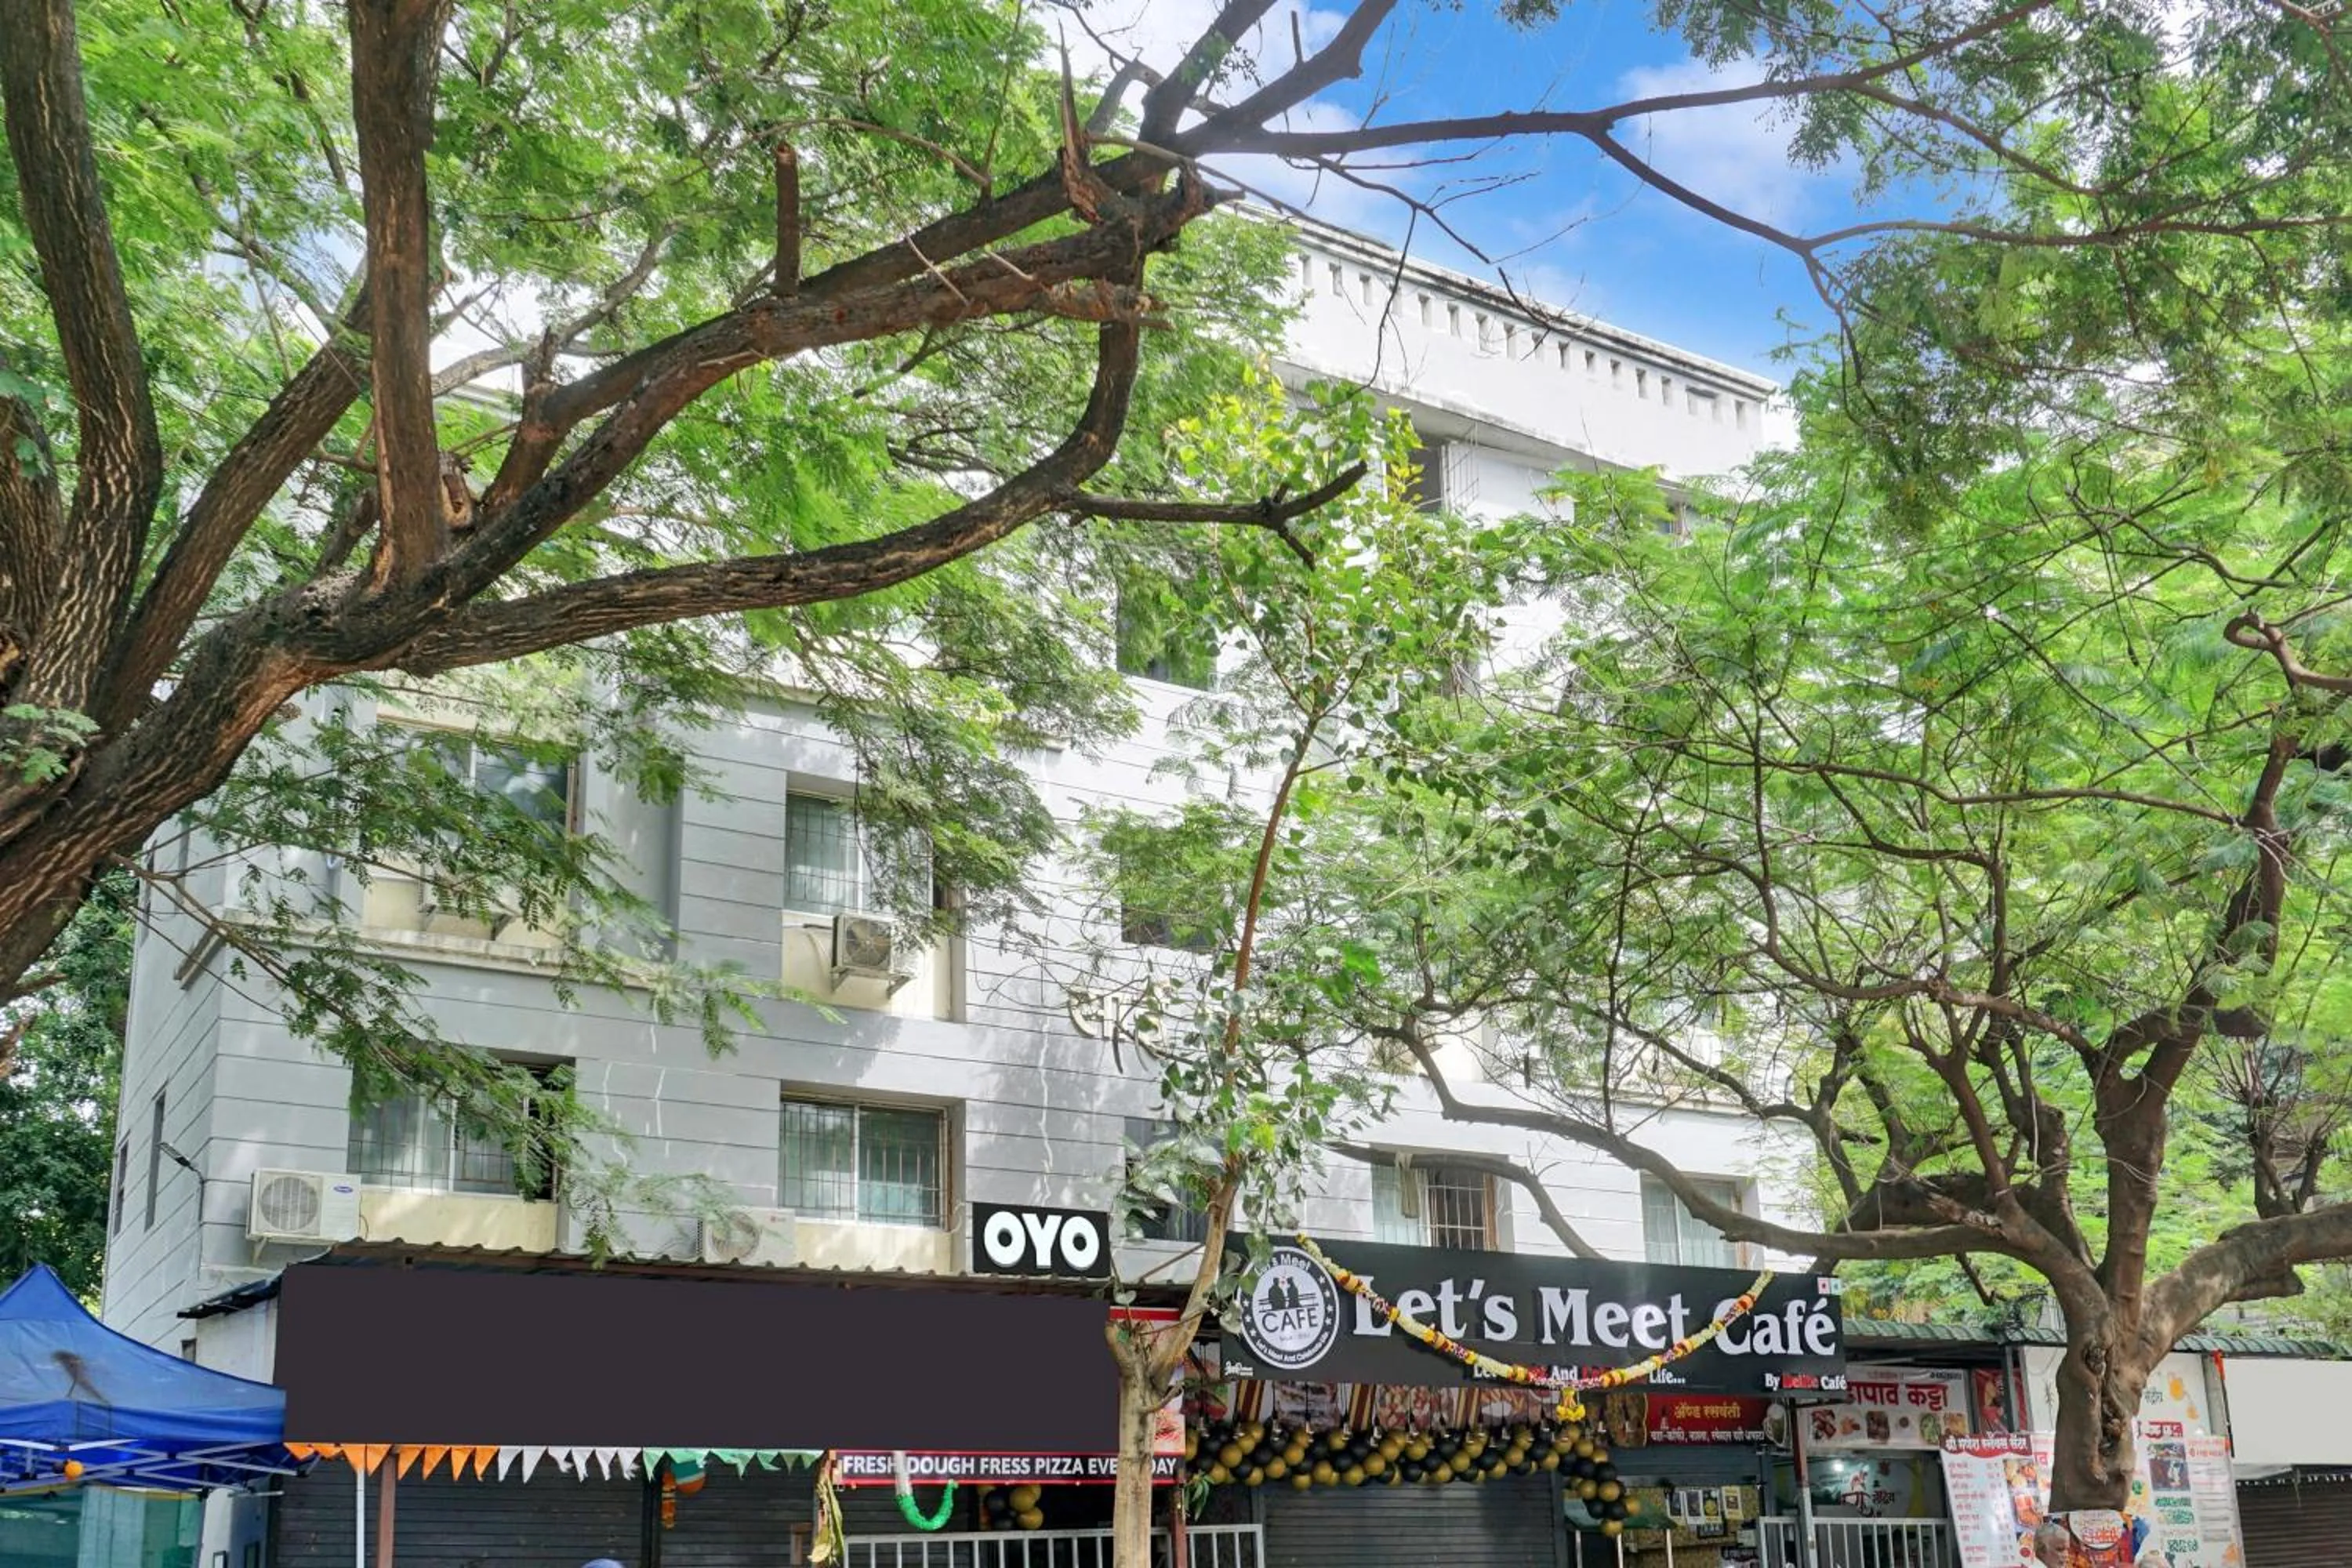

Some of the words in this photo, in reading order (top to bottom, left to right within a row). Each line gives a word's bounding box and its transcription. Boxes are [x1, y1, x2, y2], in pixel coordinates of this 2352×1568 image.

[982, 1210, 1101, 1269] OYO
[1280, 1254, 1311, 1271] Meet
[1261, 1307, 1319, 1334] CAFE
[1352, 1275, 1519, 1341] Let's
[1538, 1287, 1690, 1349] Meet
[1715, 1296, 1836, 1356] Café
[1552, 1365, 1578, 1381] And
[1765, 1373, 1780, 1392] By
[1820, 1374, 1847, 1390] Café
[1905, 1383, 1948, 1411] कट्टा
[843, 1455, 899, 1474] FRESH
[907, 1456, 975, 1475] DOUGH
[980, 1457, 1030, 1475] FRESS
[1035, 1457, 1084, 1475] PIZZA
[1088, 1457, 1177, 1475] EVEAY
